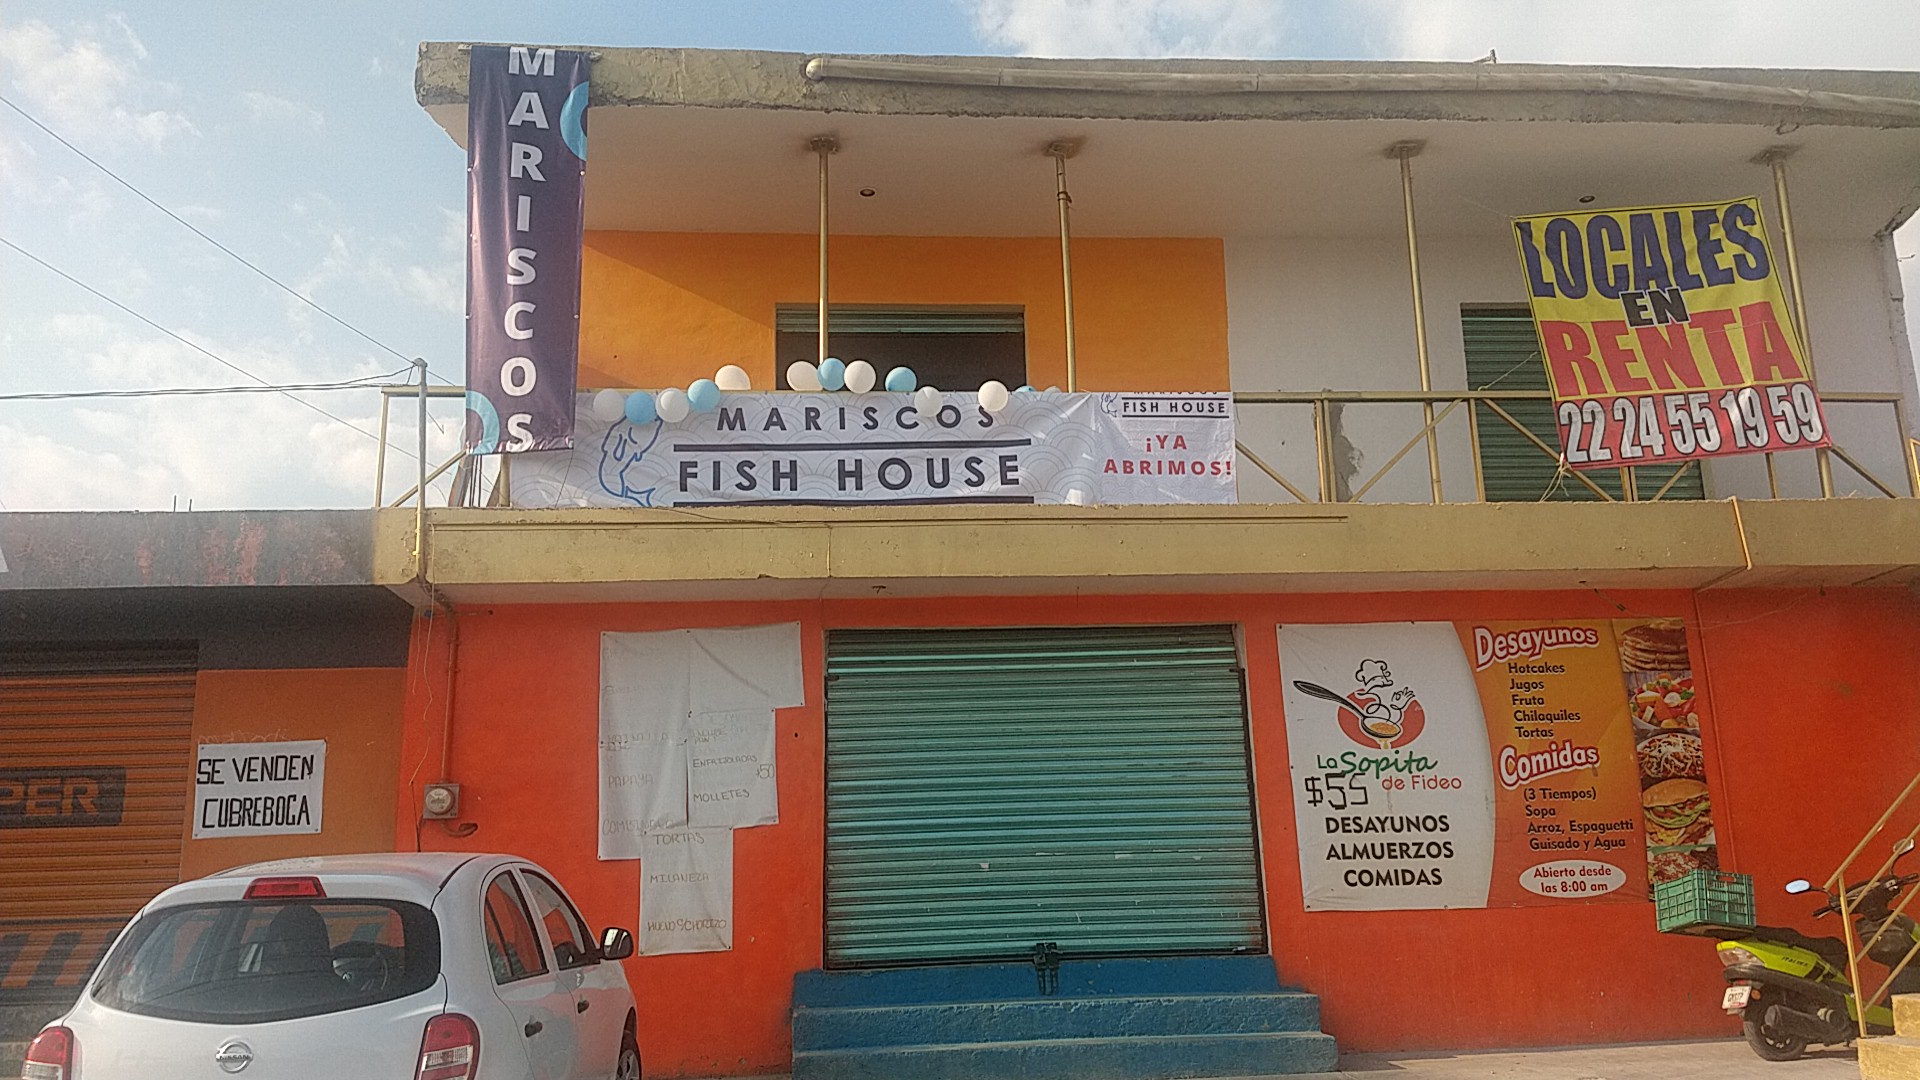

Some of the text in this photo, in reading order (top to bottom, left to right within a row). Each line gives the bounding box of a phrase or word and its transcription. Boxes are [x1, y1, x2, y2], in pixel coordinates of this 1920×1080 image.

[500, 47, 555, 452] MARISCOS
[1515, 204, 1770, 299] LOCALES
[1619, 286, 1691, 327] EN
[1540, 301, 1804, 397] RENTA
[1124, 402, 1225, 413] FISH HOUSE
[717, 405, 994, 430] MARISCOS
[1559, 383, 1823, 463] 22 24 55 19 59
[1146, 435, 1187, 452] ¡YA
[680, 455, 1020, 492] FISH HOUSE
[1104, 458, 1231, 476] ABRIMOS!
[1474, 627, 1598, 667] Desayunos
[1508, 662, 1565, 675] Hotcakes
[1510, 679, 1544, 691] Jugos
[1512, 695, 1545, 706] Fruta
[1514, 710, 1581, 723] Chilaquiles
[1515, 727, 1554, 738] Tortas
[197, 754, 314, 784] SE VENDEN
[1318, 750, 1438, 779] La Sopita
[1501, 741, 1599, 785] Comidas
[1382, 775, 1462, 790] de Fideo
[693, 789, 750, 802] MOLLETES
[1524, 787, 1596, 801] (3 Tiempos)
[202, 794, 310, 828] CUBREBOCA
[1525, 805, 1556, 818] Sopa
[1325, 815, 1450, 834] DESAYUNOS
[1528, 820, 1634, 834] Arroz, Espaguetti
[655, 832, 705, 845] TORTAS
[1529, 837, 1626, 851] Guisado y Agua
[1326, 841, 1454, 860] ALMUERZOS
[1344, 868, 1443, 887] COMIDAS
[1534, 866, 1611, 878] Abierto desde
[1541, 882, 1608, 893] las 8:00 am
